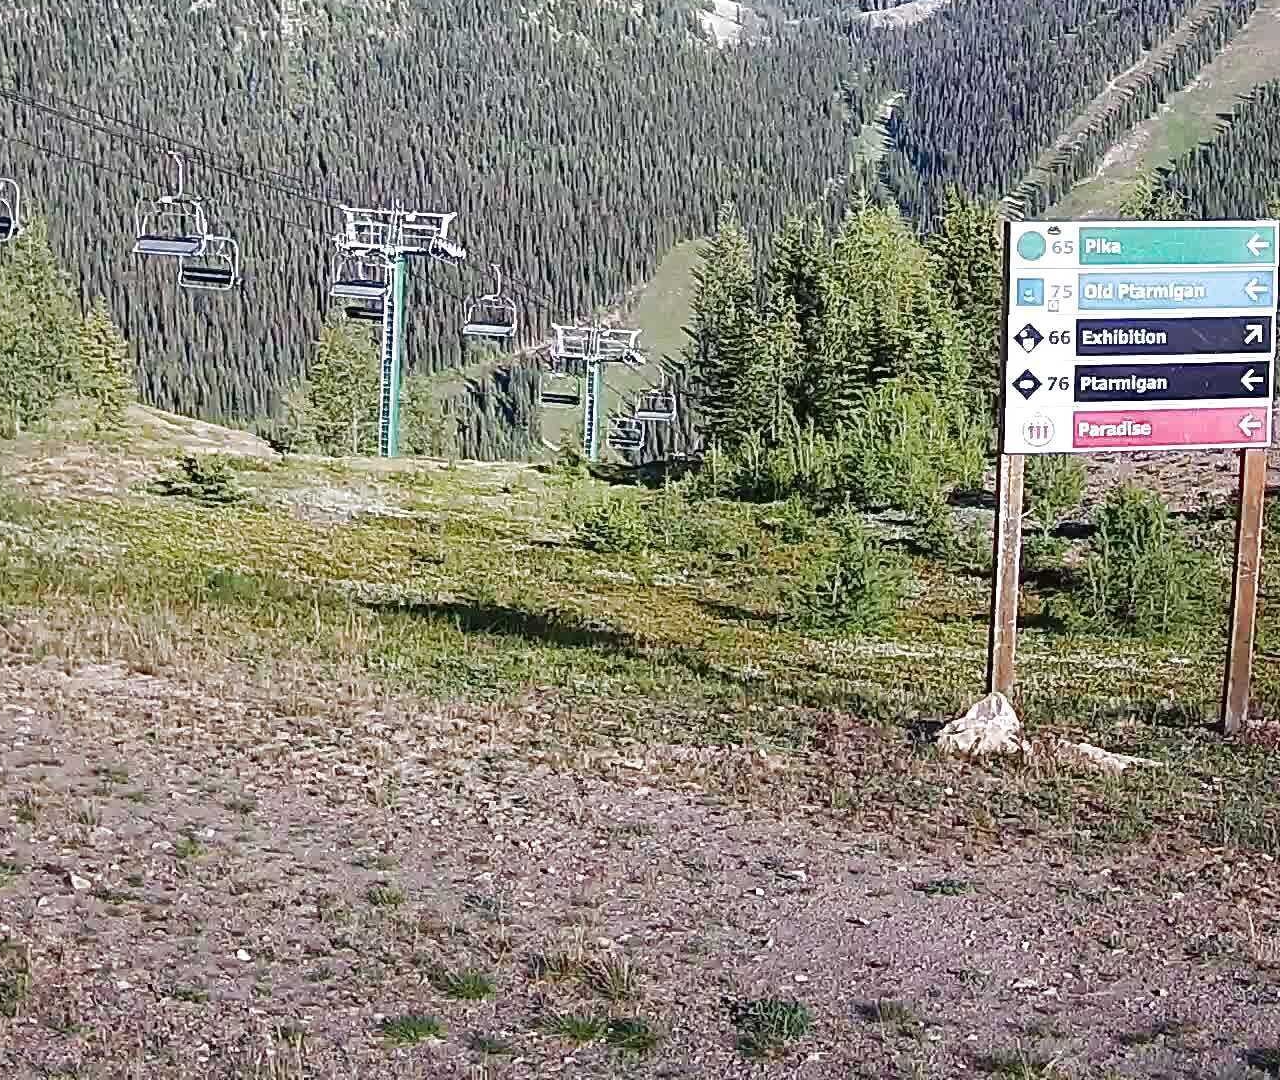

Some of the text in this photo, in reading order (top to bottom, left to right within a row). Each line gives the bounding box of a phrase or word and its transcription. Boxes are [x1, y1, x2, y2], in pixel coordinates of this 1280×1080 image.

[1051, 237, 1122, 255] 65 Pika
[1050, 282, 1206, 302] 75 Old Ptarmigan
[1048, 329, 1168, 345] 66 Exhibition
[1047, 375, 1168, 394] 76 Ptarmigan
[1078, 421, 1153, 438] Paradise
